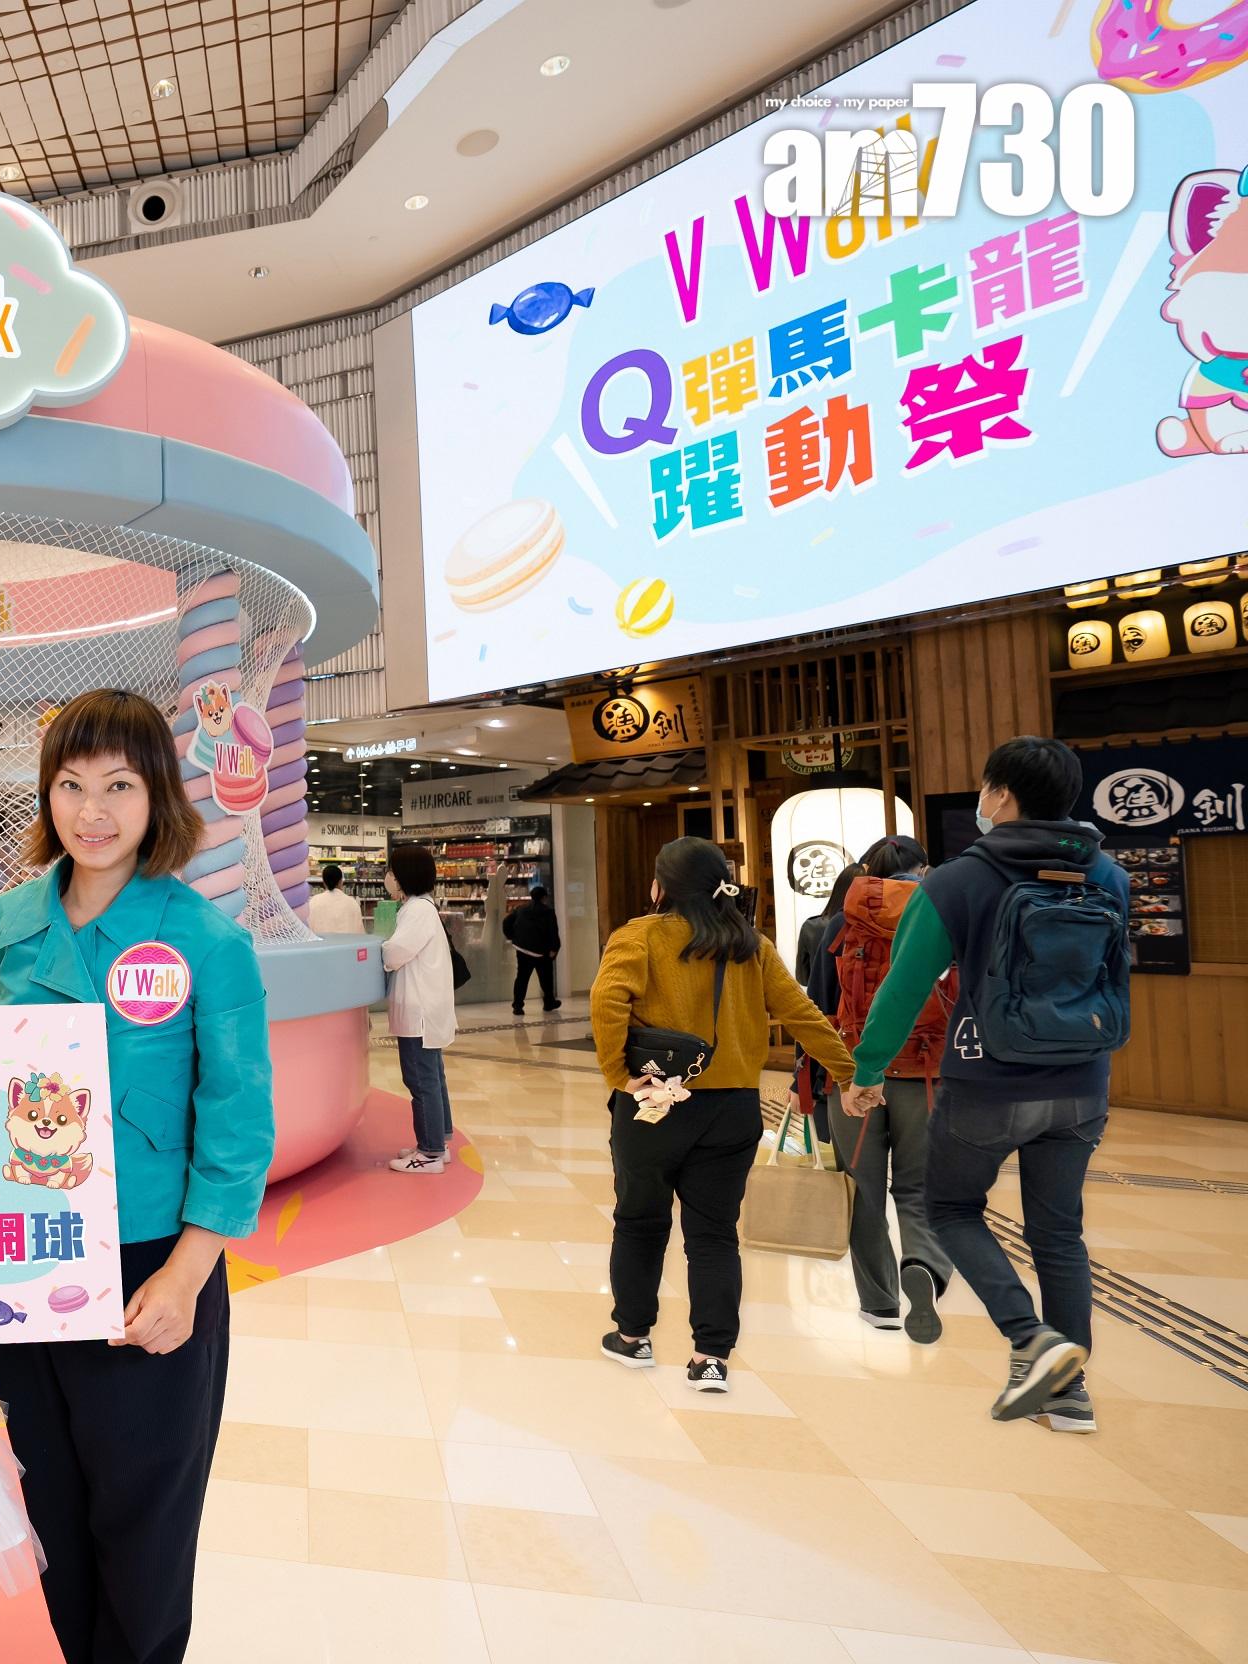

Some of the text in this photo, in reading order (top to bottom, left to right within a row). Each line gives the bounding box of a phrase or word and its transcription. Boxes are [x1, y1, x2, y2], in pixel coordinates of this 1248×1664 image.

[664, 216, 704, 324] V
[581, 211, 1084, 454] Q彈馬卡龍
[650, 334, 1032, 540] 躍動祭
[215, 743, 255, 776] V Walk
[117, 968, 180, 997] V Walk
